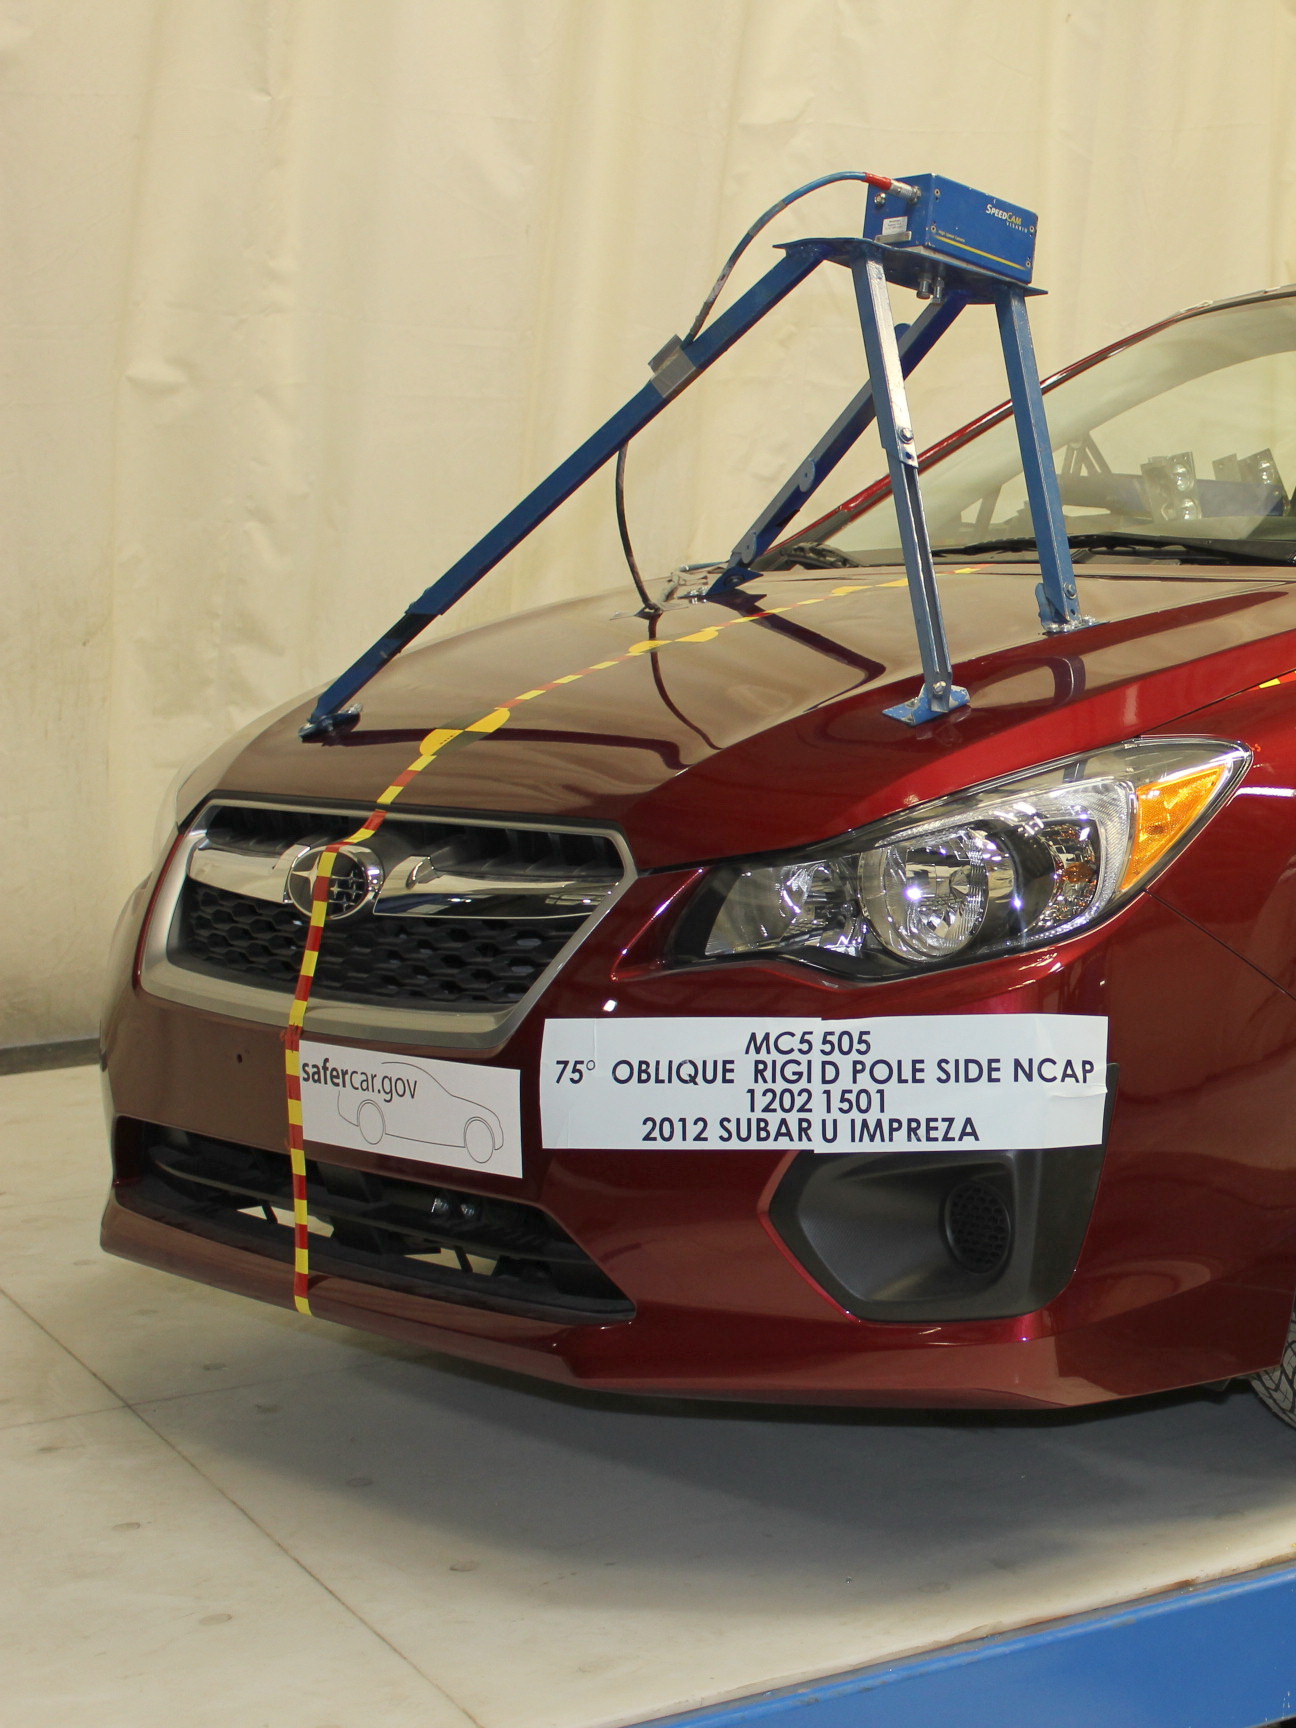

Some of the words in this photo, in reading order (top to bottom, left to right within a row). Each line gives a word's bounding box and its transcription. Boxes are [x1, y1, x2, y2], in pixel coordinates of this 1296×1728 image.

[744, 1030, 872, 1056] MC5505
[301, 1057, 418, 1103] safercar.gov
[555, 1058, 596, 1085] 75°
[611, 1058, 736, 1086] OBLIQUE
[752, 1059, 841, 1085] RIGID
[851, 1059, 925, 1085] POLE
[935, 1058, 1002, 1085] SIDE
[1012, 1057, 1096, 1084] NCAP
[745, 1088, 886, 1115] 12021501
[641, 1116, 709, 1143] 2012
[717, 1116, 838, 1144] SUBARU
[850, 1116, 980, 1143] IMPREZA
